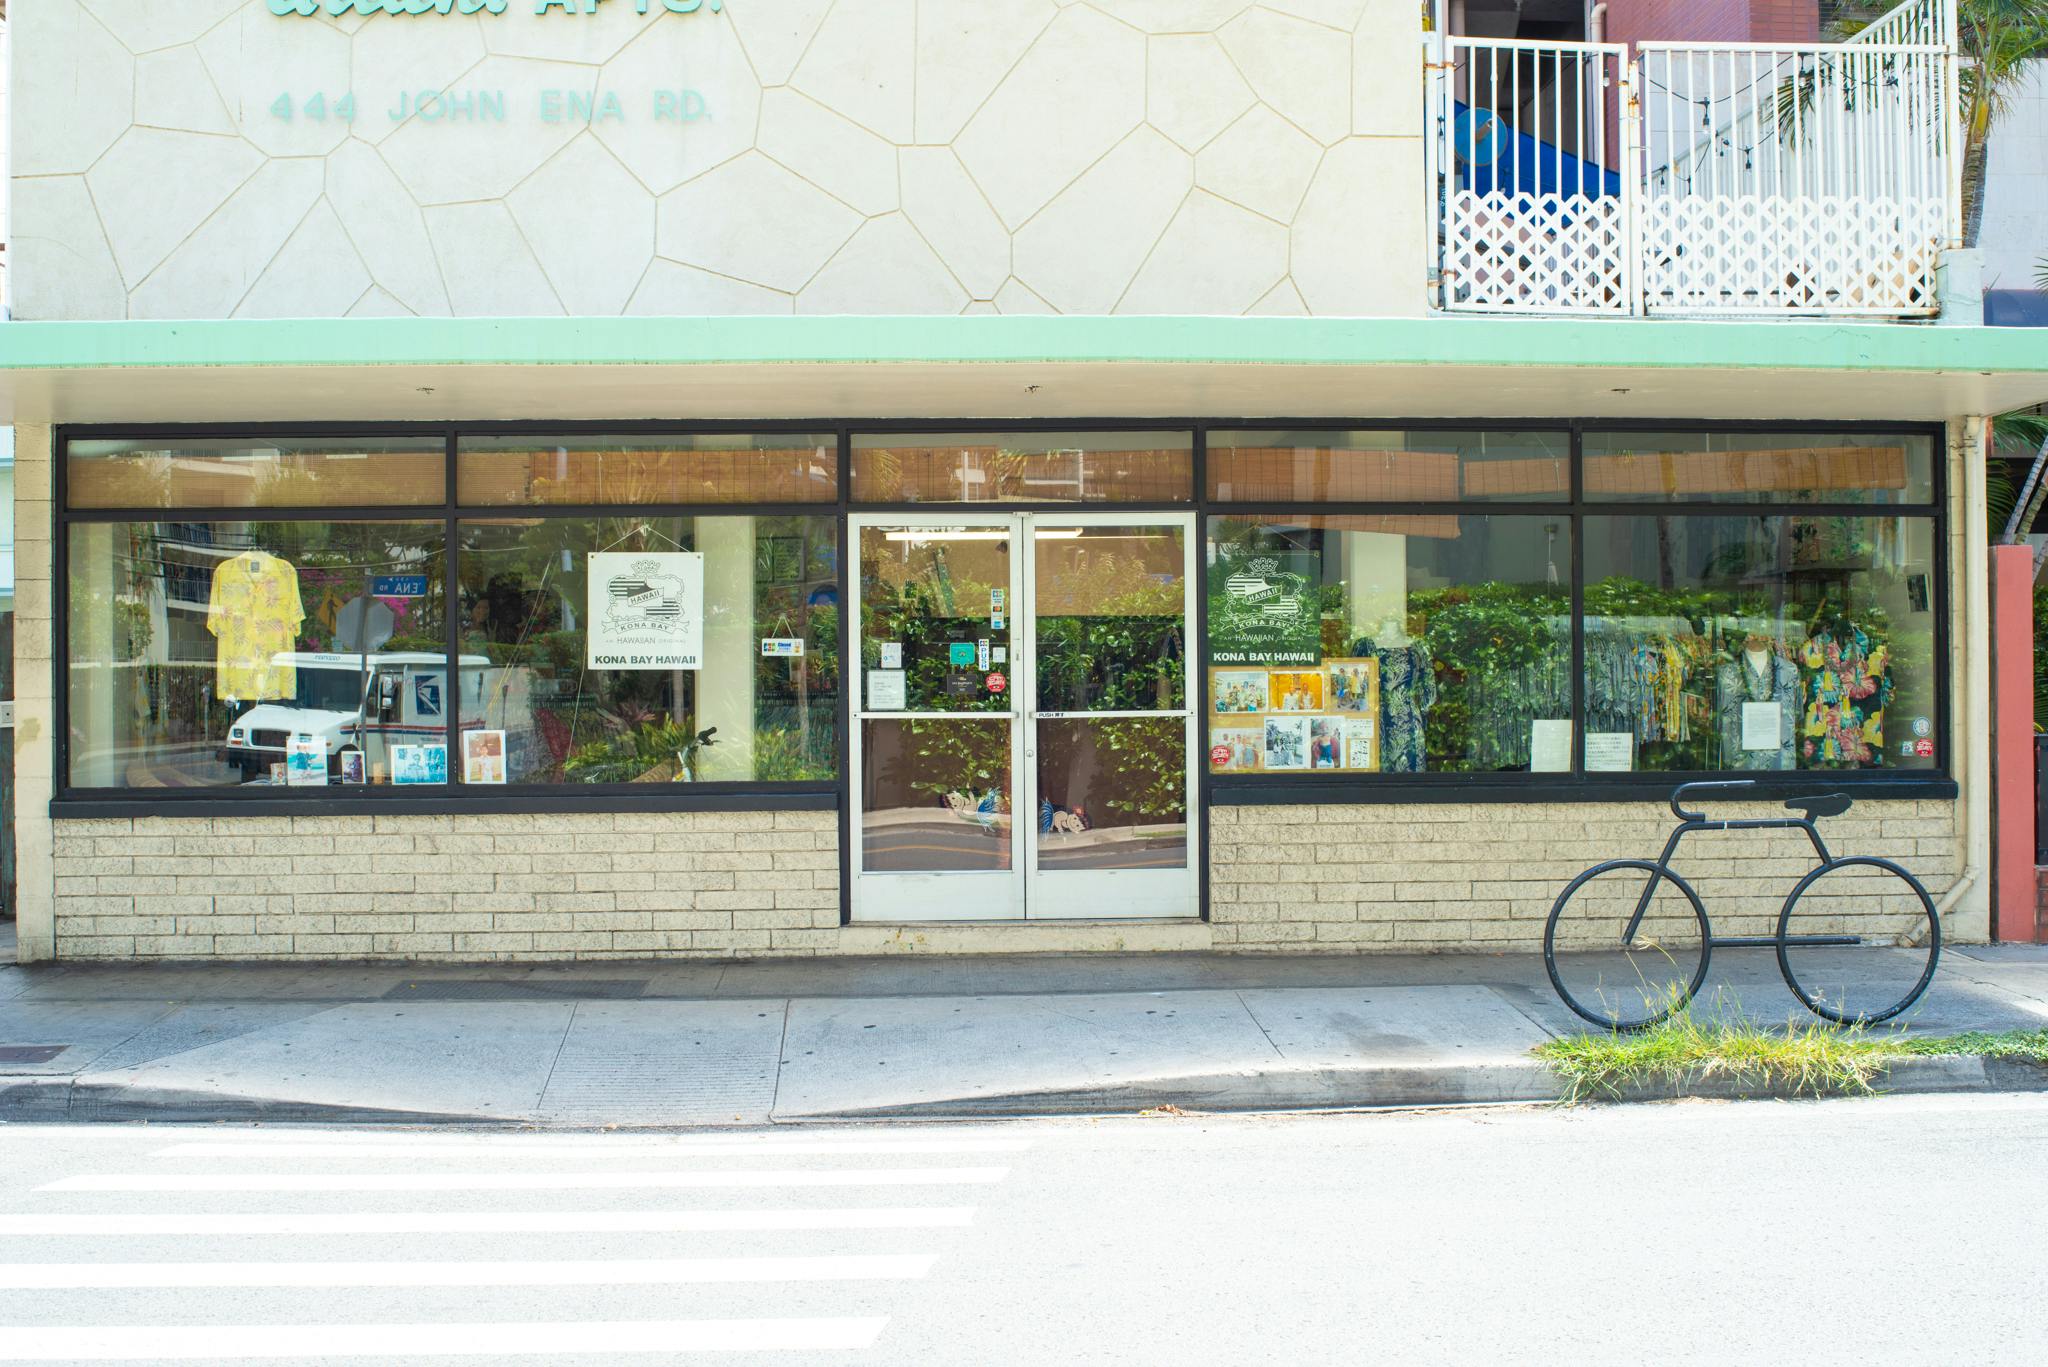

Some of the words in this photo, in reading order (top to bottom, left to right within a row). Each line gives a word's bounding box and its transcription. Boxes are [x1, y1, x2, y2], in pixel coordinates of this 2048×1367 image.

[270, 91, 355, 122] 444
[388, 90, 504, 121] JOHN
[540, 91, 625, 121] ENA
[654, 91, 712, 121] RD.
[631, 590, 660, 605] HAWAII
[1248, 587, 1277, 602] HAWAII
[620, 622, 647, 631] KONA
[651, 622, 669, 631] BAY
[1239, 620, 1265, 629] KONA
[1269, 620, 1287, 628] BAY
[595, 655, 627, 664] KONA
[630, 655, 653, 664] BAY
[656, 655, 696, 664] HAWAII
[1213, 652, 1246, 661] KONA
[1249, 652, 1272, 661] BAY
[1274, 652, 1314, 662] HAWAII
